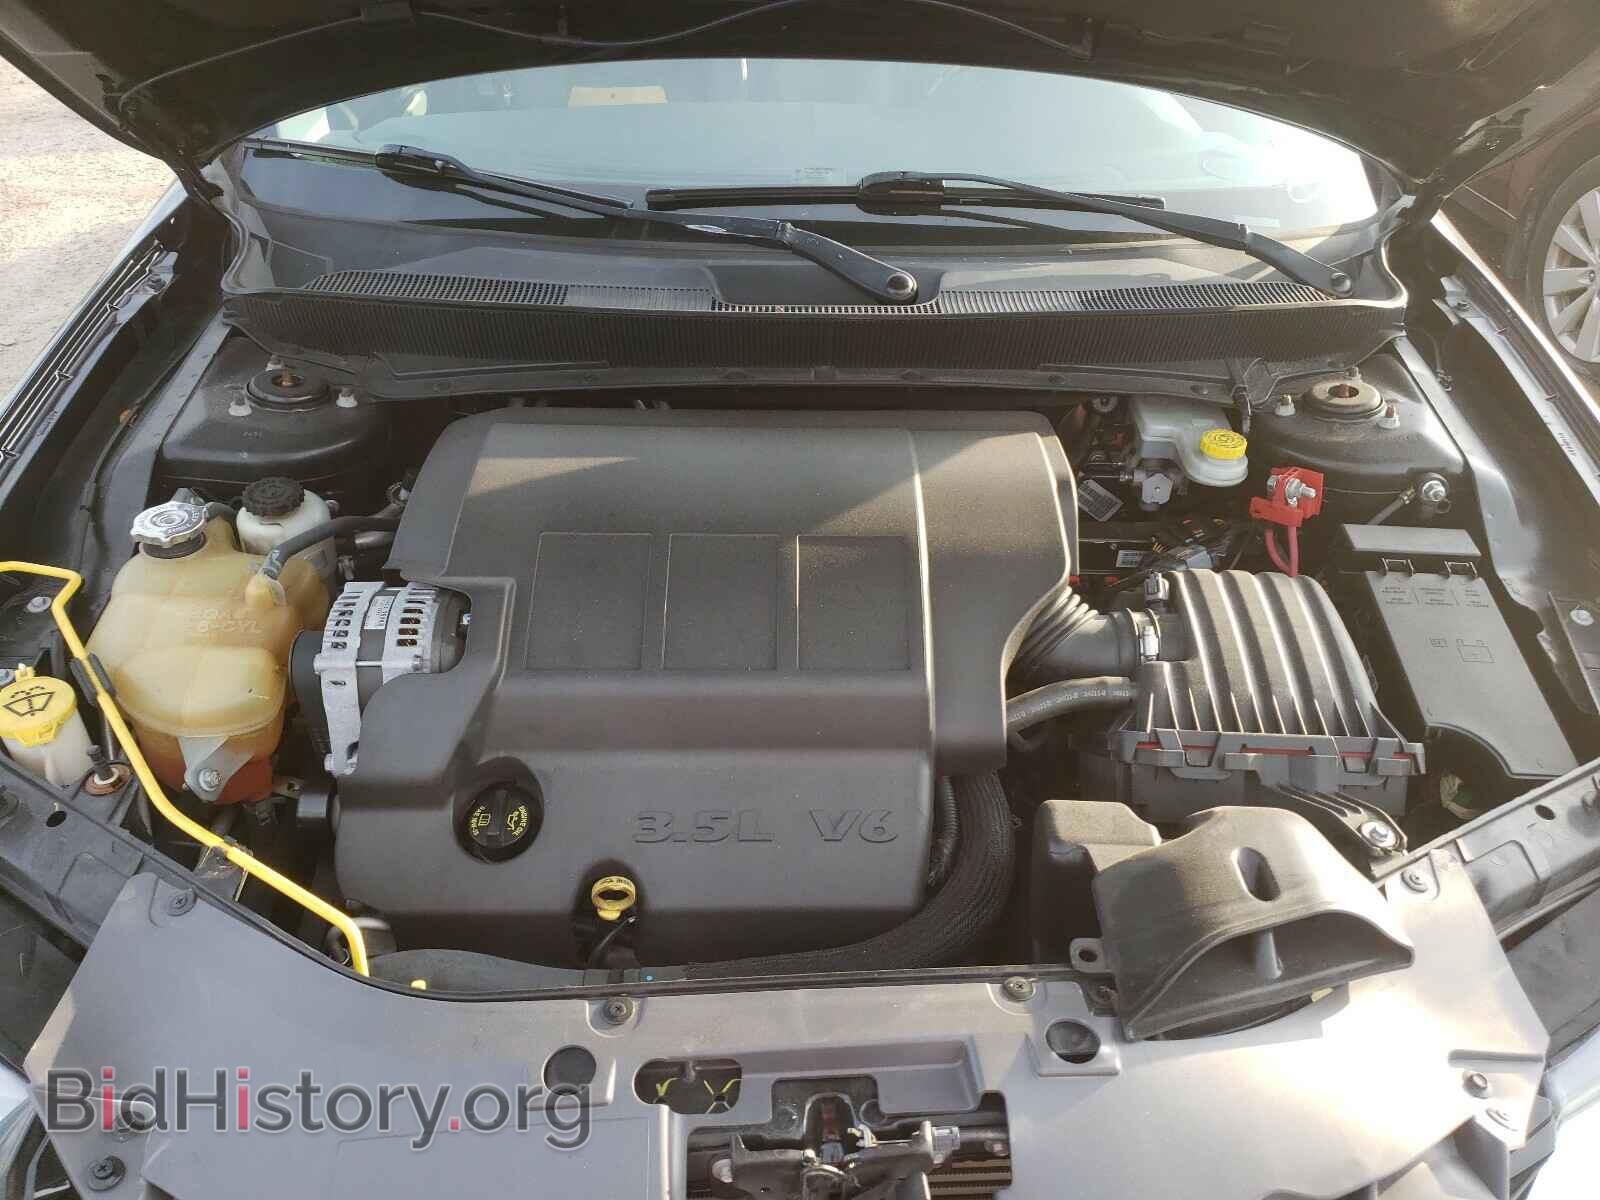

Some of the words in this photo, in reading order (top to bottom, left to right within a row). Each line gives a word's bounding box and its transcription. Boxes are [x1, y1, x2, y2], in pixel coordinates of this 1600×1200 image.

[518, 805, 528, 827] ENGINE
[632, 809, 776, 844] 3.5L
[808, 808, 899, 844] V6
[511, 826, 524, 837] OIL
